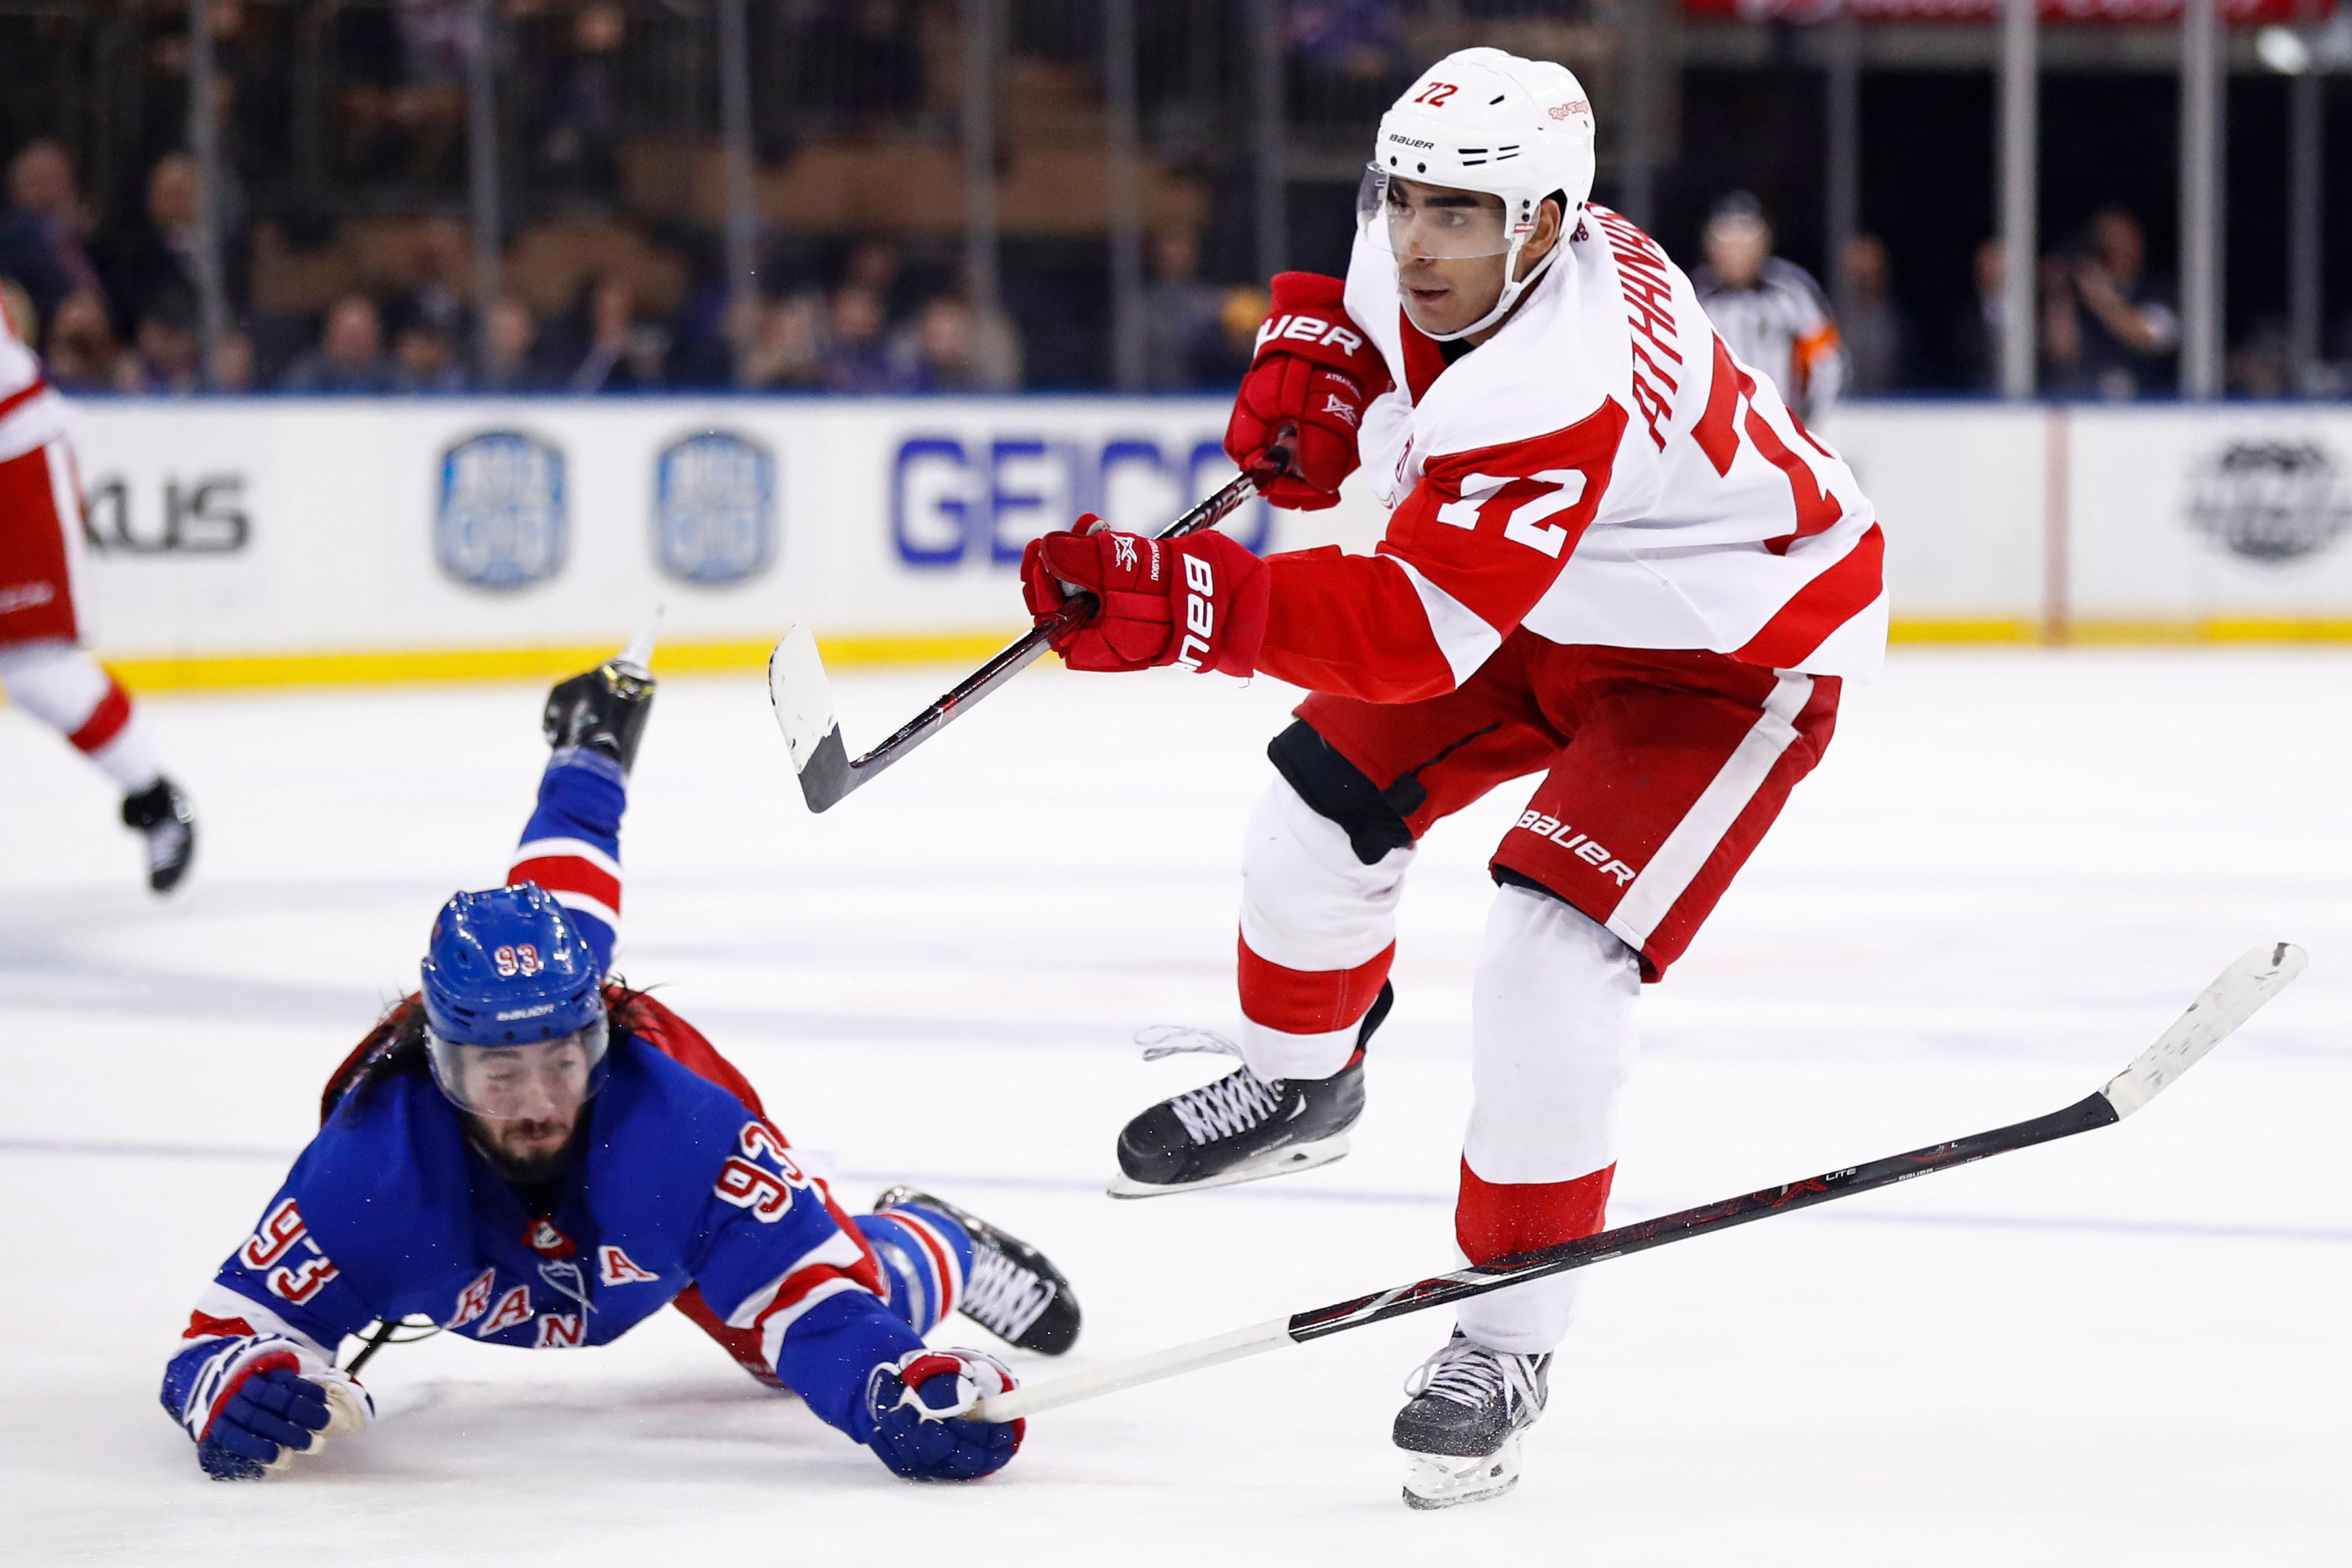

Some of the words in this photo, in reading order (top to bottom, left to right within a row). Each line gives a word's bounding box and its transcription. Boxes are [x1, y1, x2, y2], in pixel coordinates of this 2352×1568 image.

[1414, 82, 1459, 108] 72
[1253, 314, 1363, 357] UER
[1436, 469, 1588, 560] 72
[495, 944, 540, 976] 93
[713, 1120, 811, 1224] 93
[1825, 1167, 1857, 1181] LITE
[238, 1198, 341, 1307] 93
[598, 1245, 660, 1287] A
